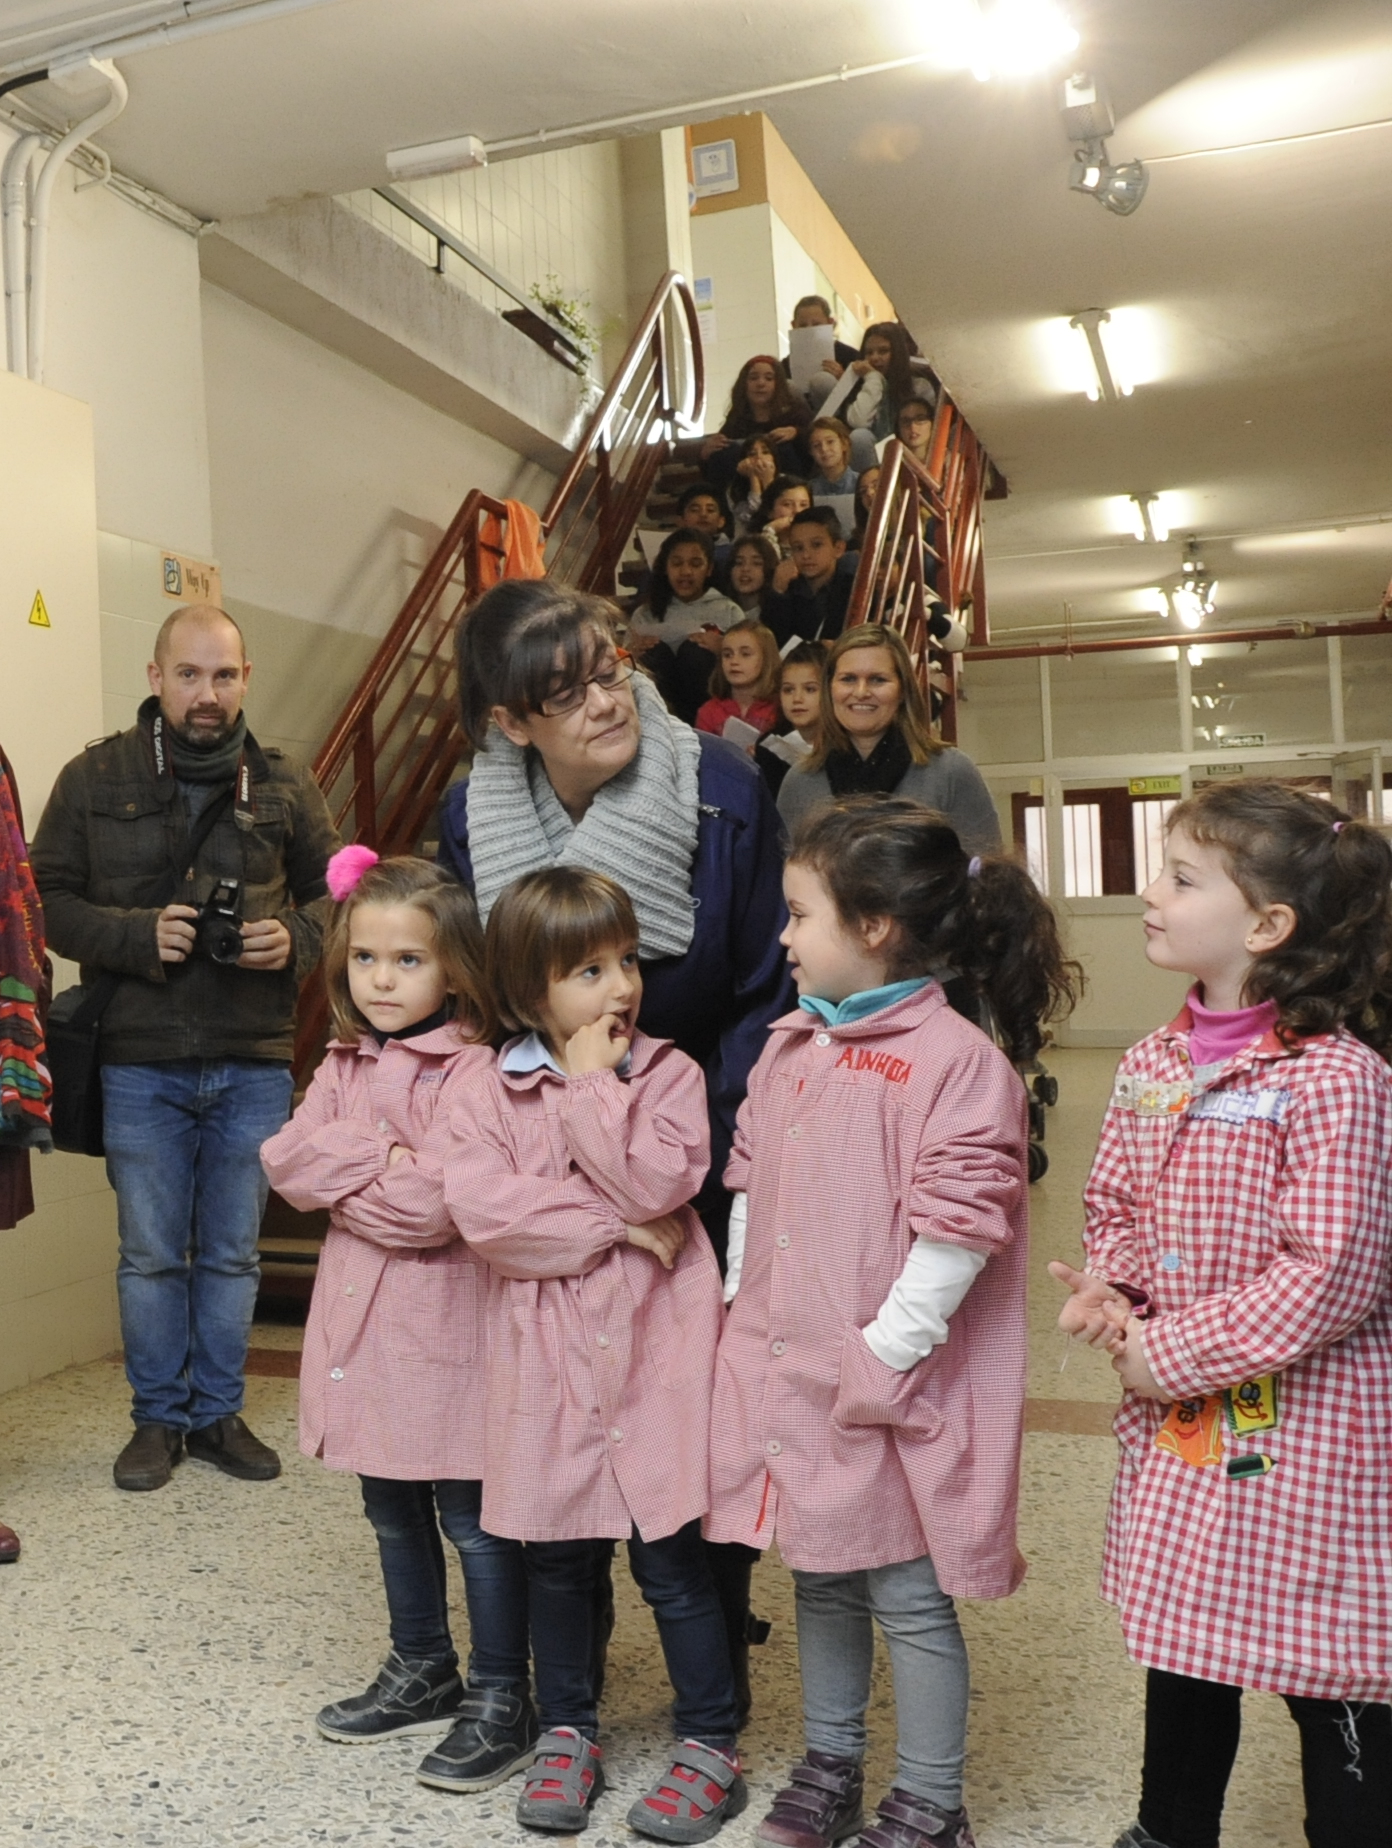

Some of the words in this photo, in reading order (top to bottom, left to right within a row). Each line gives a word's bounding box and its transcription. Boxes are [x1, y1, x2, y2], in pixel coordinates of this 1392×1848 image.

[240, 765, 249, 802] Canon
[1152, 780, 1171, 790] EXIT
[834, 1045, 913, 1085] AINHOA
